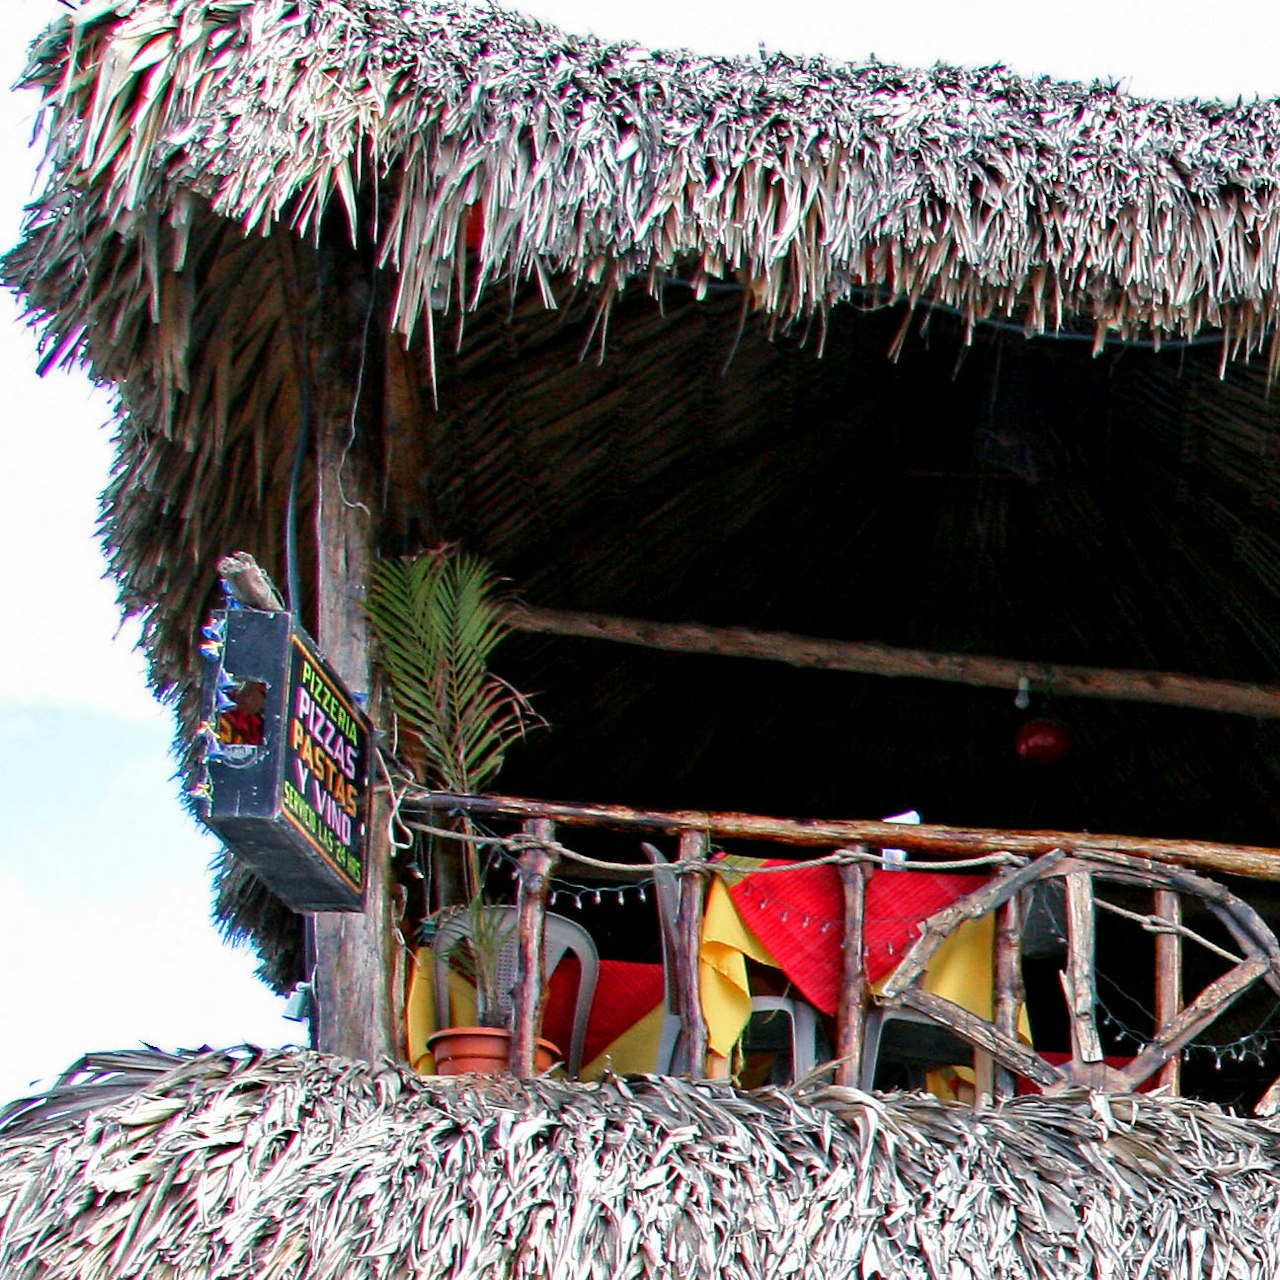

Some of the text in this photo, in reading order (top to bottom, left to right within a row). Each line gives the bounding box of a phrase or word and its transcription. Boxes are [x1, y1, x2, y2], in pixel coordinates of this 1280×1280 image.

[296, 687, 358, 780] PIZZAS
[303, 661, 358, 746] PIZZERIA
[290, 717, 358, 818] PASTAS
[294, 758, 352, 846] Y VINO
